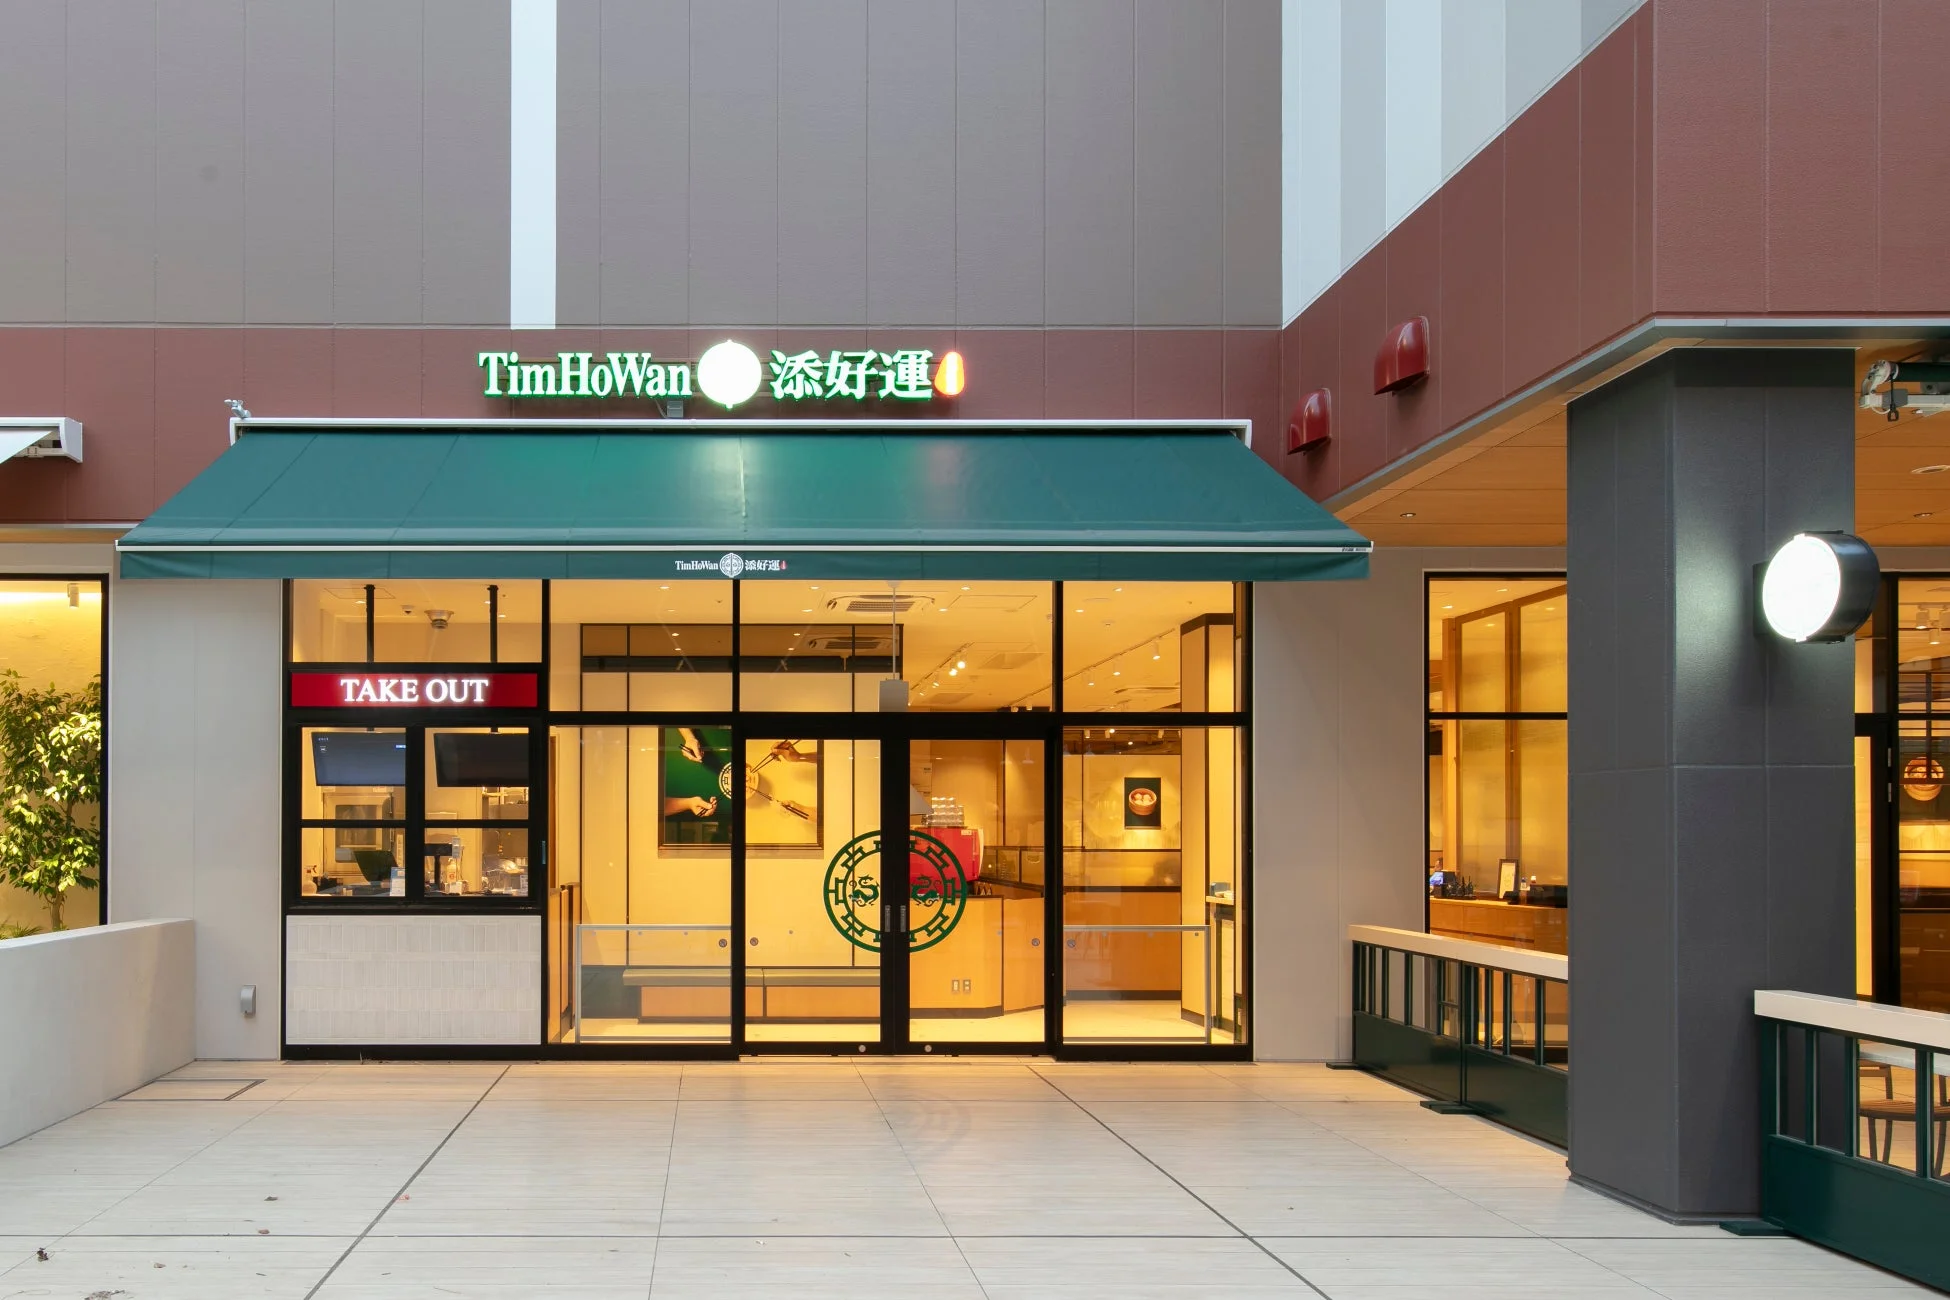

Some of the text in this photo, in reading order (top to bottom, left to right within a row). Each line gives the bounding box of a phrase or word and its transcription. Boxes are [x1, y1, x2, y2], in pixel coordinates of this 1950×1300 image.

[478, 349, 934, 400] TimHoWan 添好運
[675, 560, 780, 571] TimHoWan 添好運
[340, 678, 489, 703] TAKE OUT
